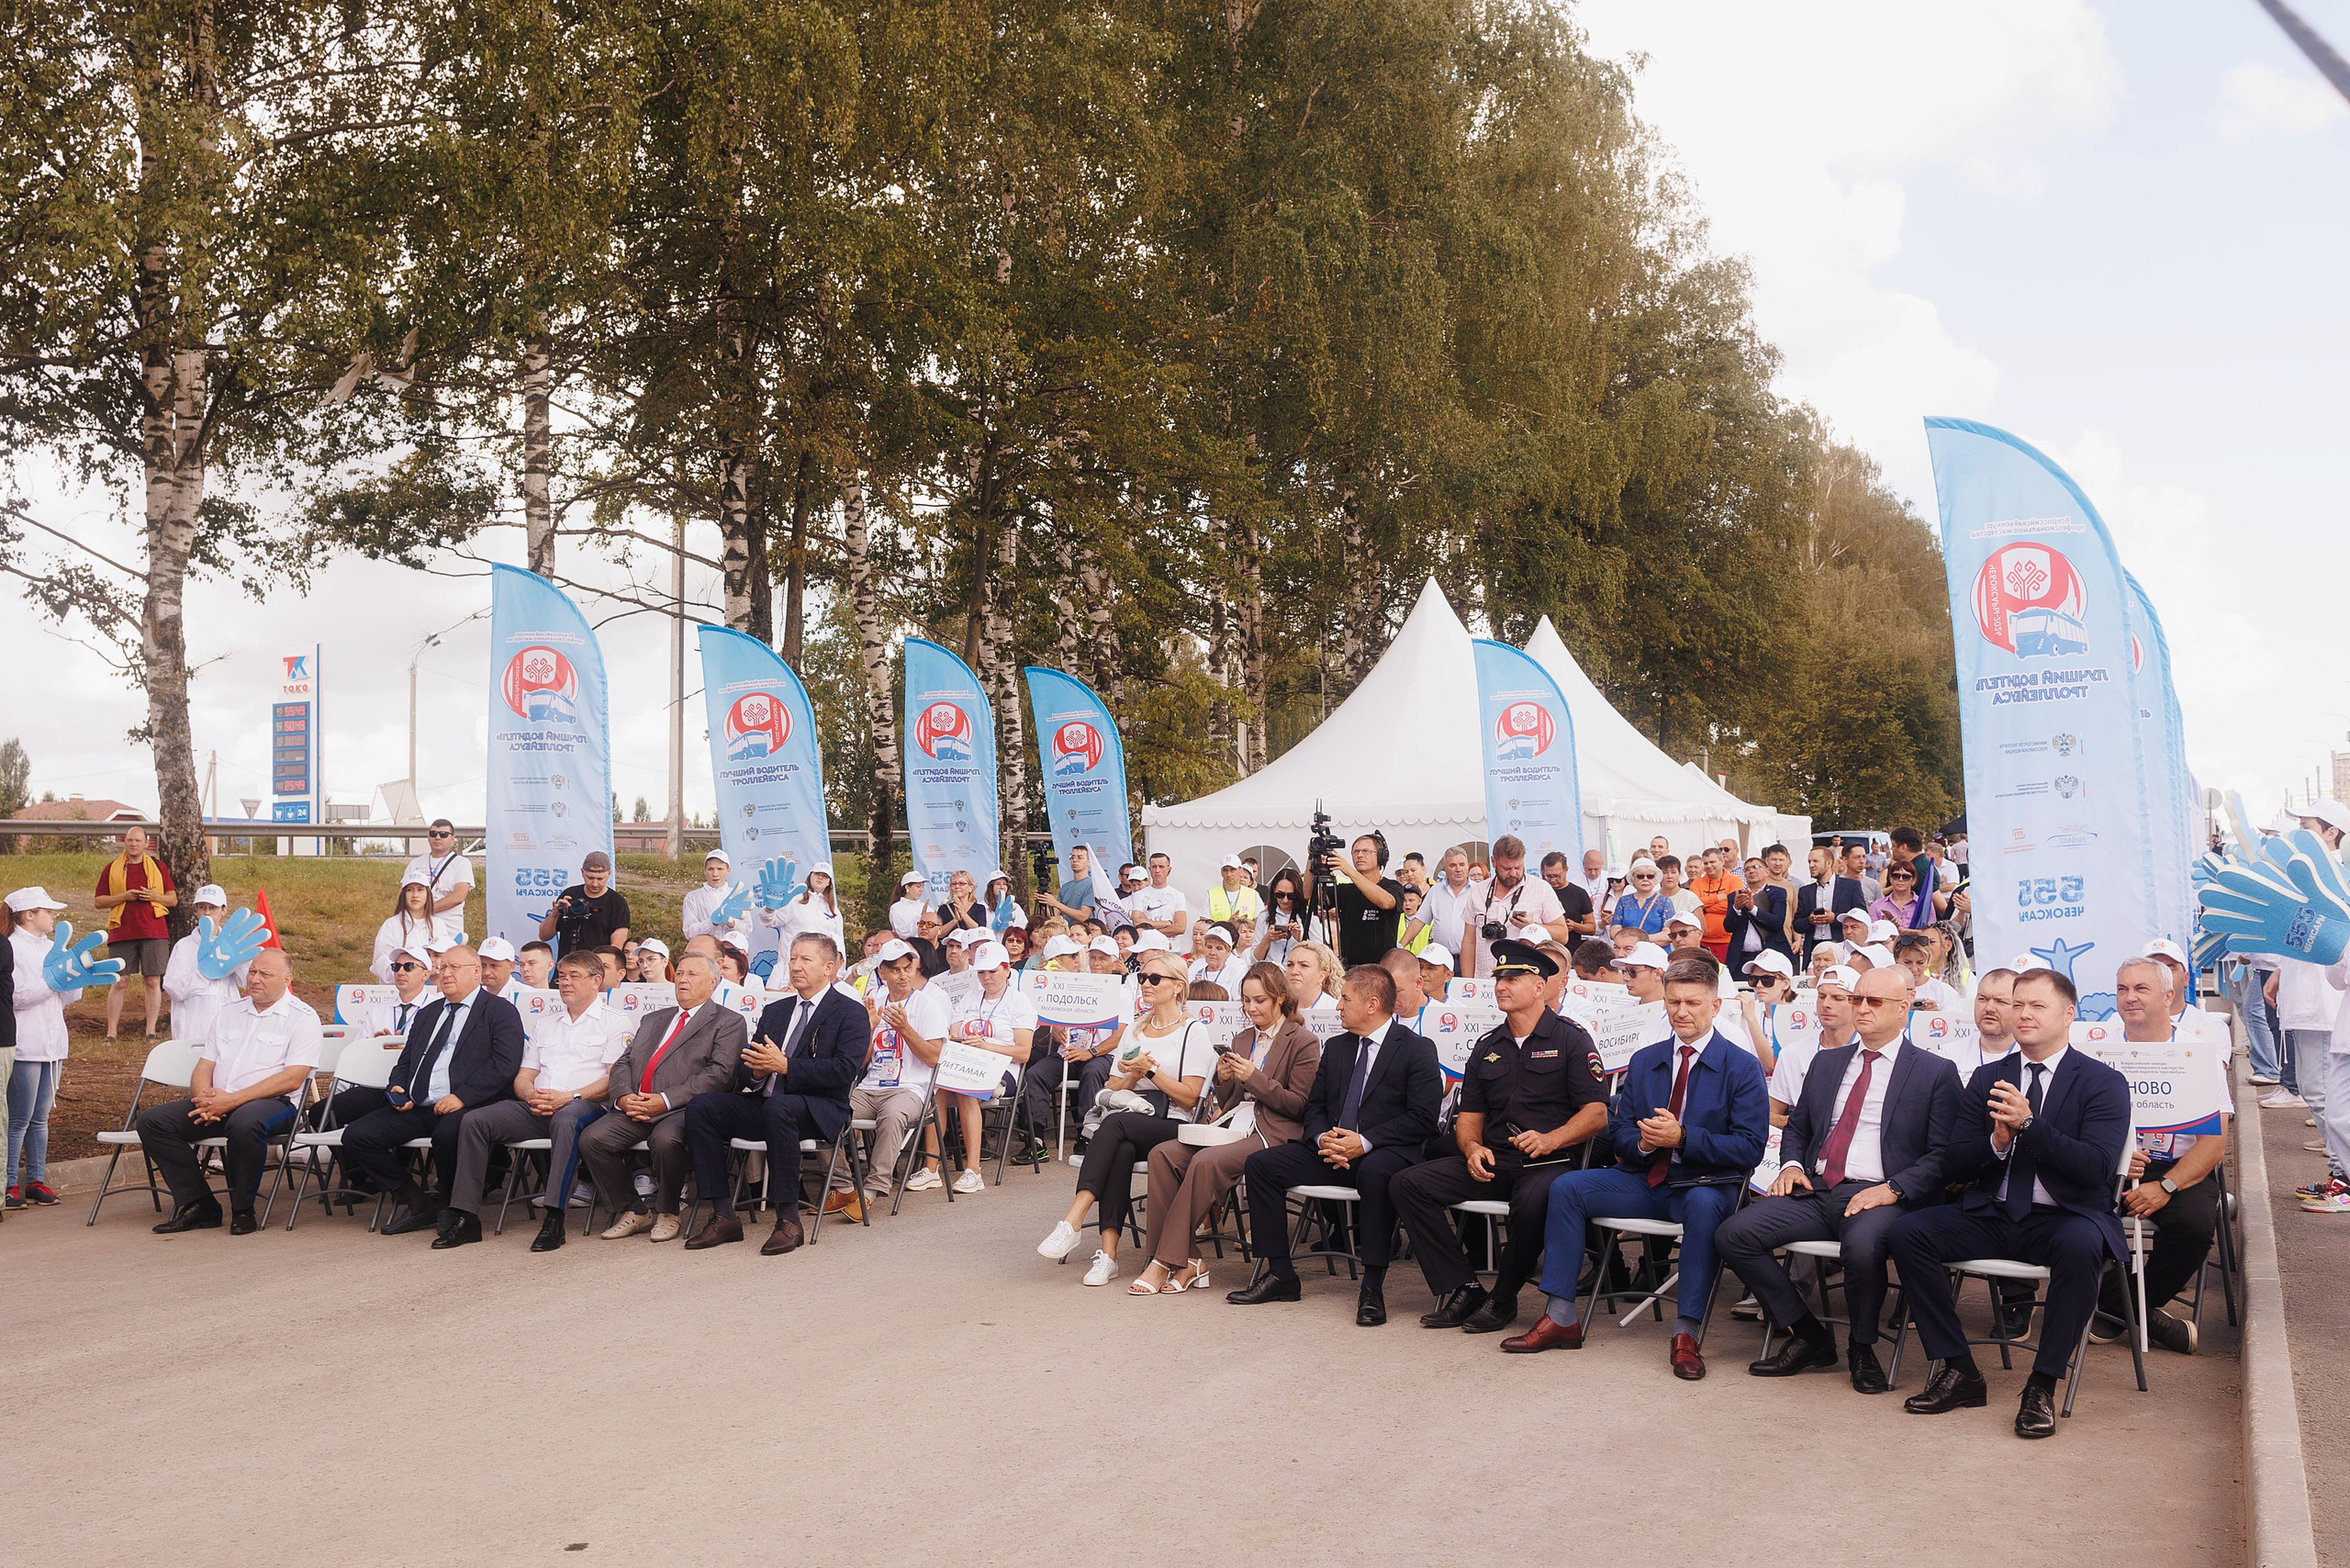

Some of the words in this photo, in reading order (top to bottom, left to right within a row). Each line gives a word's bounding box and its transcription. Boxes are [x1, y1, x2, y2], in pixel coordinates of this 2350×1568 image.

[720, 767, 755, 778] ЛУЧШИЙ
[756, 764, 800, 775] ВОДИТЕЛЬ
[1490, 767, 1521, 776] ЛУЧШИЙ
[1522, 766, 1561, 774] ВОДИТЕЛЬ
[732, 774, 789, 787] ТРОЛЛЕЙБУСА
[1077, 778, 1109, 787] ВОДИТЕЛЬ
[1499, 774, 1551, 783] ТРОЛЛЕЙБУСА
[1046, 993, 1098, 1006] ПОДОЛЬСК
[1311, 1024, 1326, 1034] XXI
[1463, 1023, 1480, 1033] XXI
[1598, 1032, 1639, 1050] ВОСИБИР
[941, 1059, 987, 1079] ЛИТАМАК
[2129, 1081, 2172, 1095] НОВО
[2136, 1099, 2175, 1109] область
